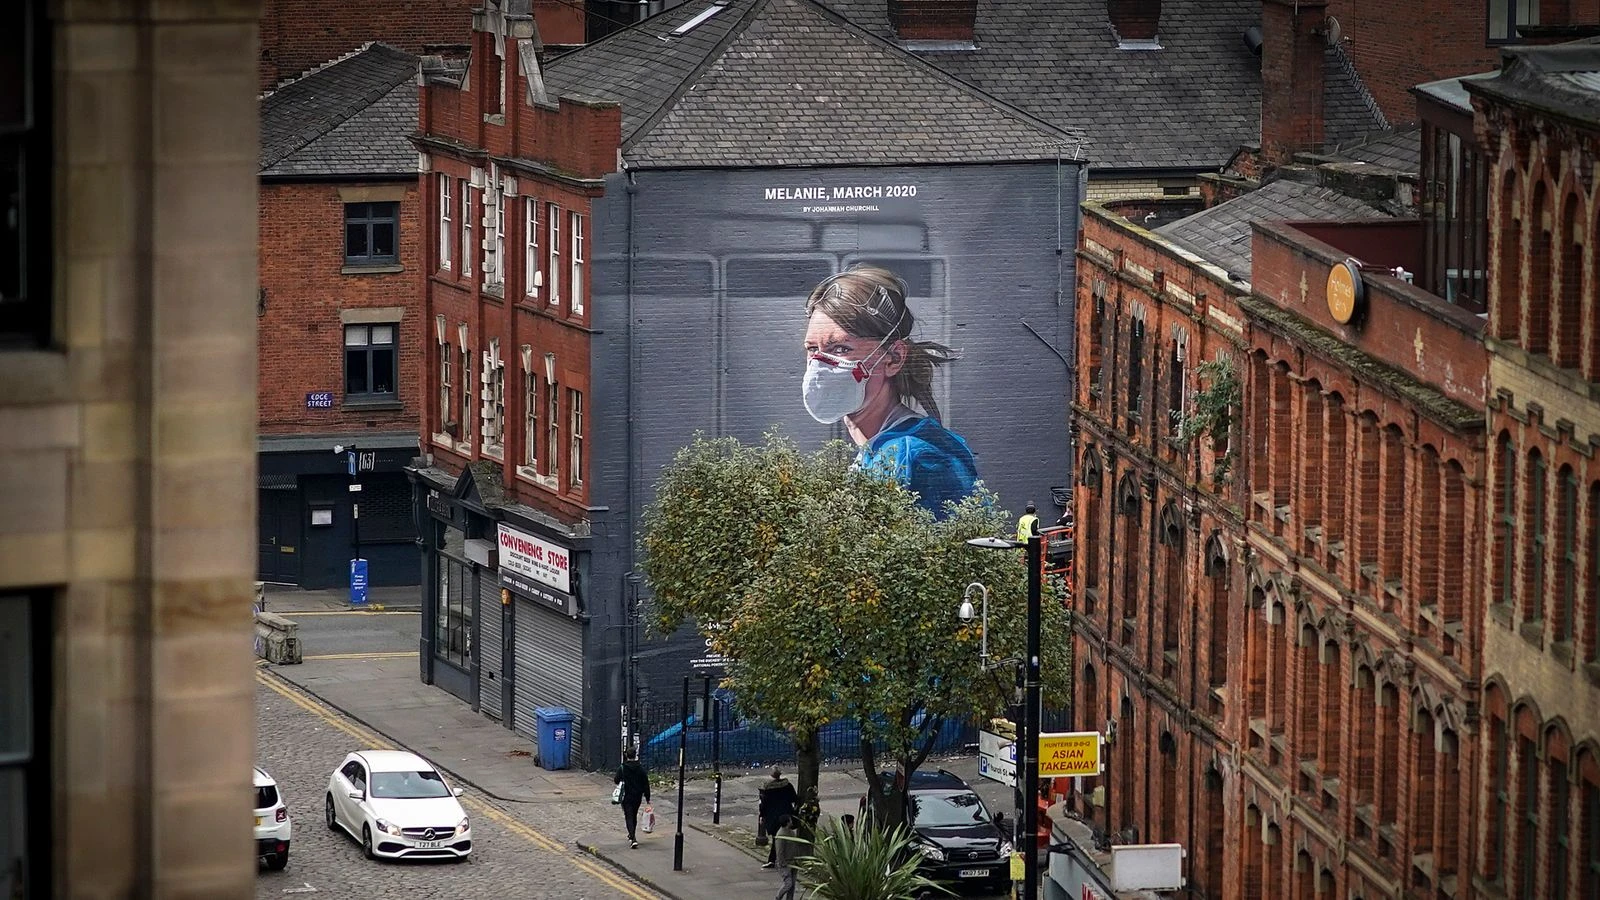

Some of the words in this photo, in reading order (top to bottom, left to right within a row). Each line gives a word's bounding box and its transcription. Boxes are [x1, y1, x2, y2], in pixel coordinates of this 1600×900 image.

[765, 187, 830, 201] MELANIE,
[833, 186, 882, 199] MARCH
[885, 185, 917, 198] 2020
[500, 532, 543, 561] CONVENIENCE
[547, 550, 568, 571] STORE
[1052, 749, 1084, 760] ASIAN
[1040, 760, 1097, 771] TAKEAWAY
